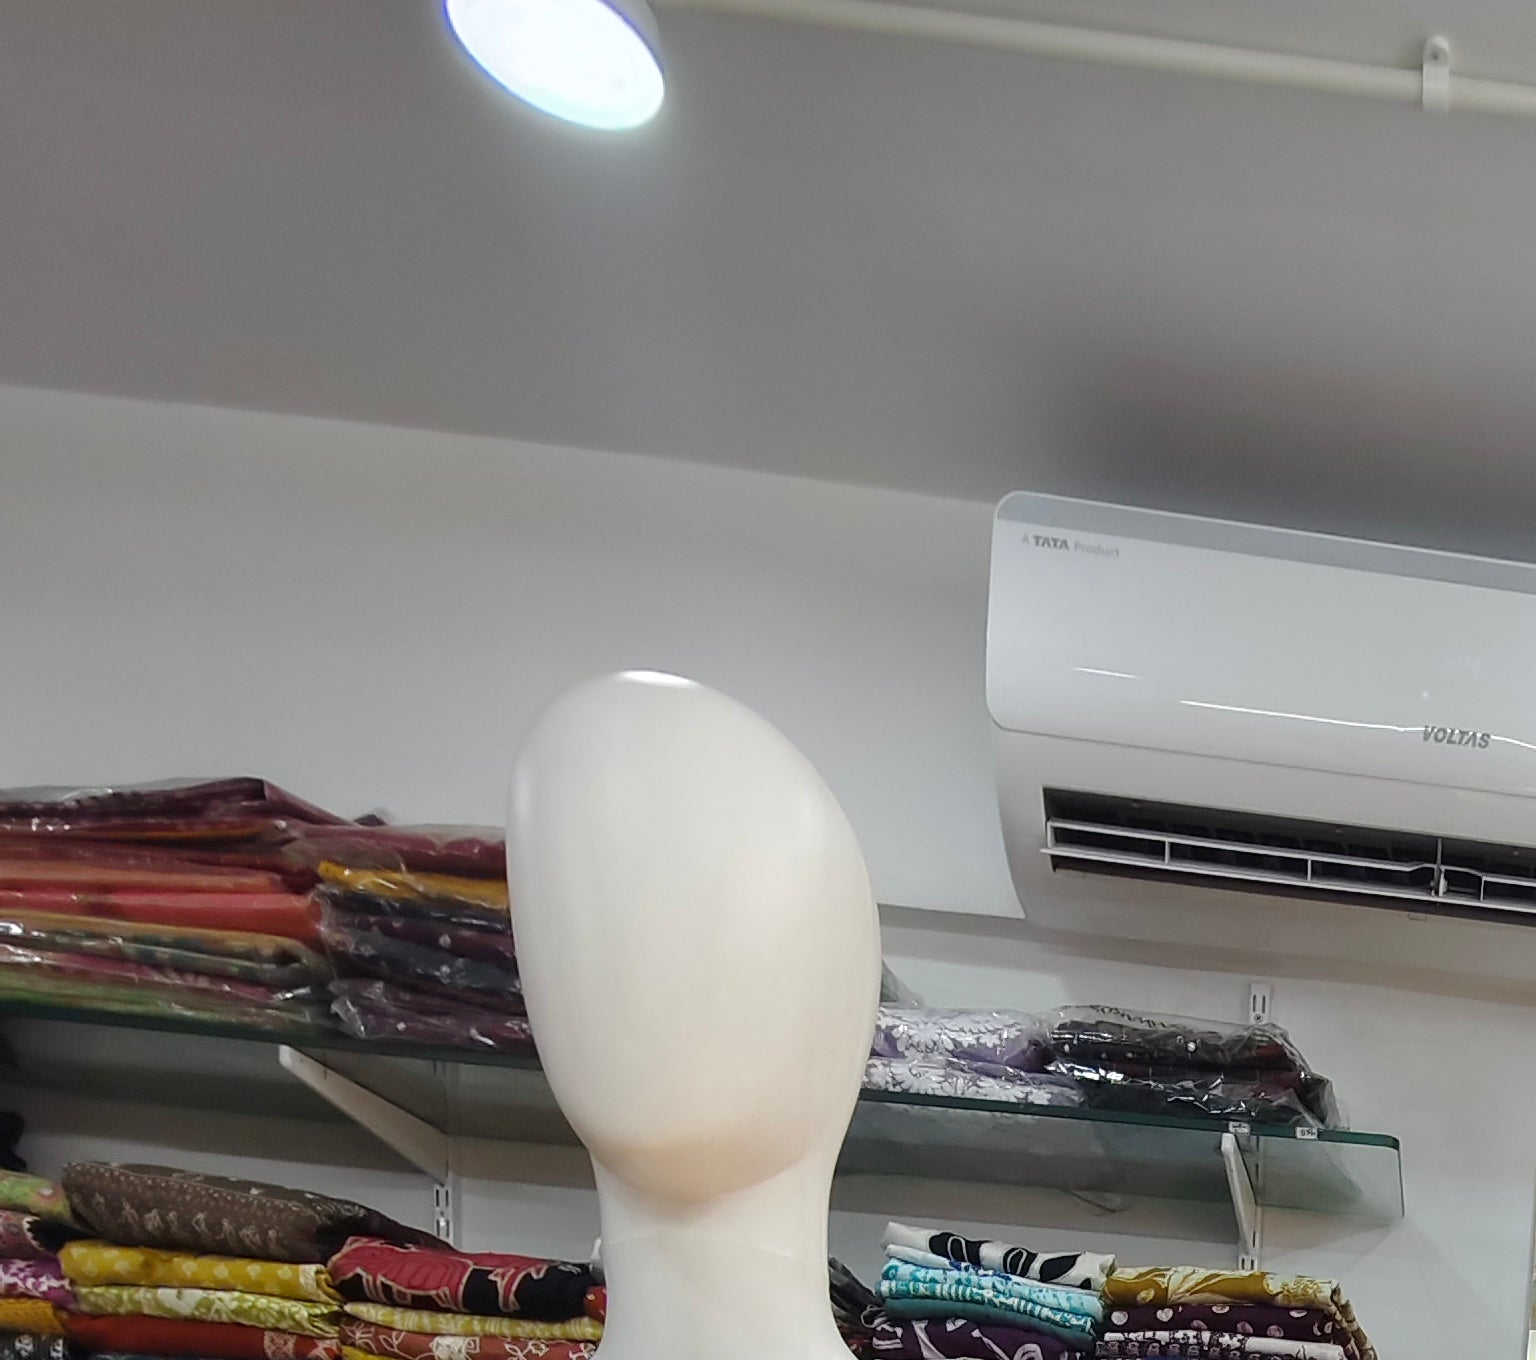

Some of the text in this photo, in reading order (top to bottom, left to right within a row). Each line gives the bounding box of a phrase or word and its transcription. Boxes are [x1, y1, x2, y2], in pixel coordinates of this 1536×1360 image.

[1021, 533, 1120, 559] A TATA Product
[1423, 725, 1491, 749] VOLTAS
